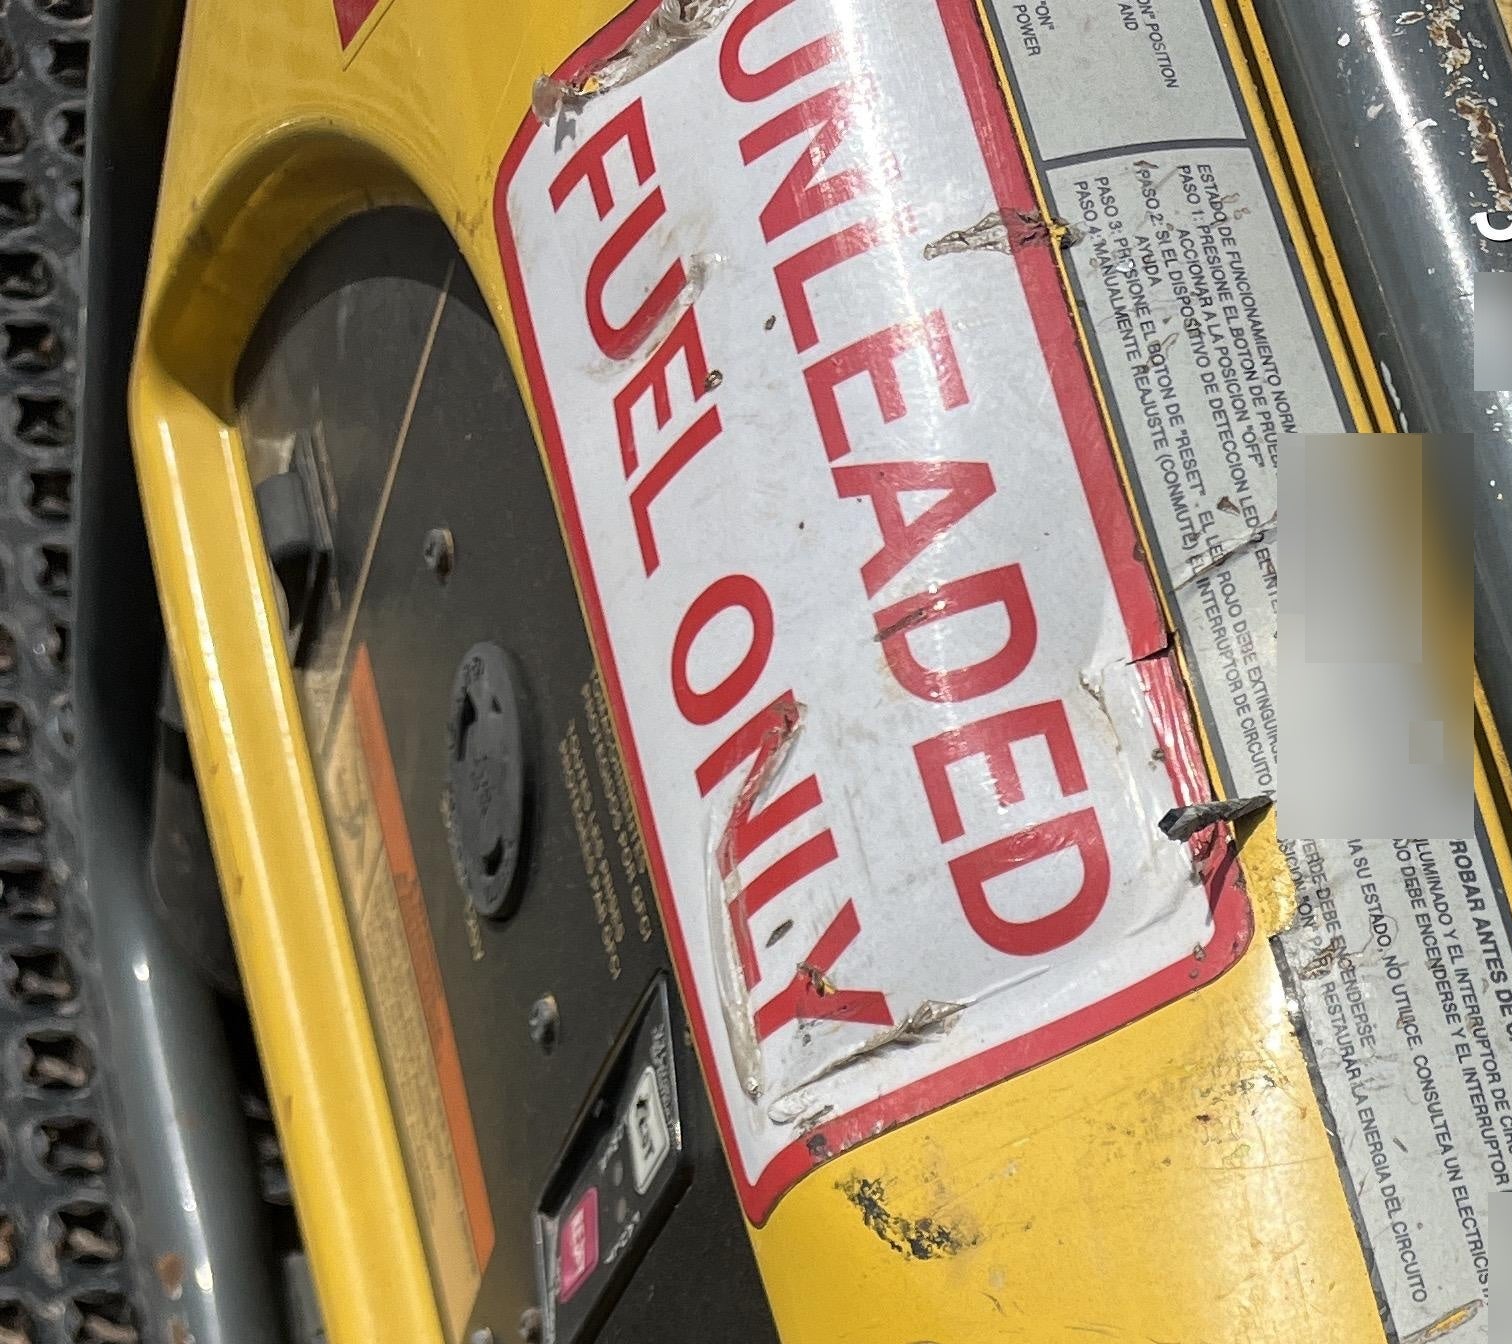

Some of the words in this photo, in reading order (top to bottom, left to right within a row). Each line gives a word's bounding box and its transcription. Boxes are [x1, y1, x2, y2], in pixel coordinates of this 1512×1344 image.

[1011, 3, 1042, 56] POWER
[1116, 1, 1140, 31] AND
[1144, 22, 1180, 89] POSITION
[1195, 163, 1229, 222] ESTADO
[1132, 234, 1164, 287] AYUDA
[1216, 225, 1237, 247] DE
[1174, 227, 1215, 308] ACCIONAR
[1212, 345, 1251, 422] POSICION
[1237, 424, 1266, 468] "OFF"
[1224, 250, 1283, 387] FUNCIONAMIENTO
[720, 0, 1110, 955] UNLEADED
[549, 98, 722, 576] FUEL
[672, 574, 893, 1039] ONLY
[1398, 862, 1427, 910] DEBE
[1413, 912, 1462, 1025] ENCENDERSE
[1445, 943, 1466, 965] EL
[1471, 915, 1509, 984] ANTES
[1351, 856, 1373, 880] SU
[1380, 954, 1405, 981] NO
[1441, 1156, 1464, 1182] UN
[1452, 967, 1502, 1084] INTERRUPTOR
[1453, 1042, 1474, 1064] EL
[1460, 1066, 1511, 1186] INTERRUPTOR
[1489, 1087, 1511, 1112] DE
